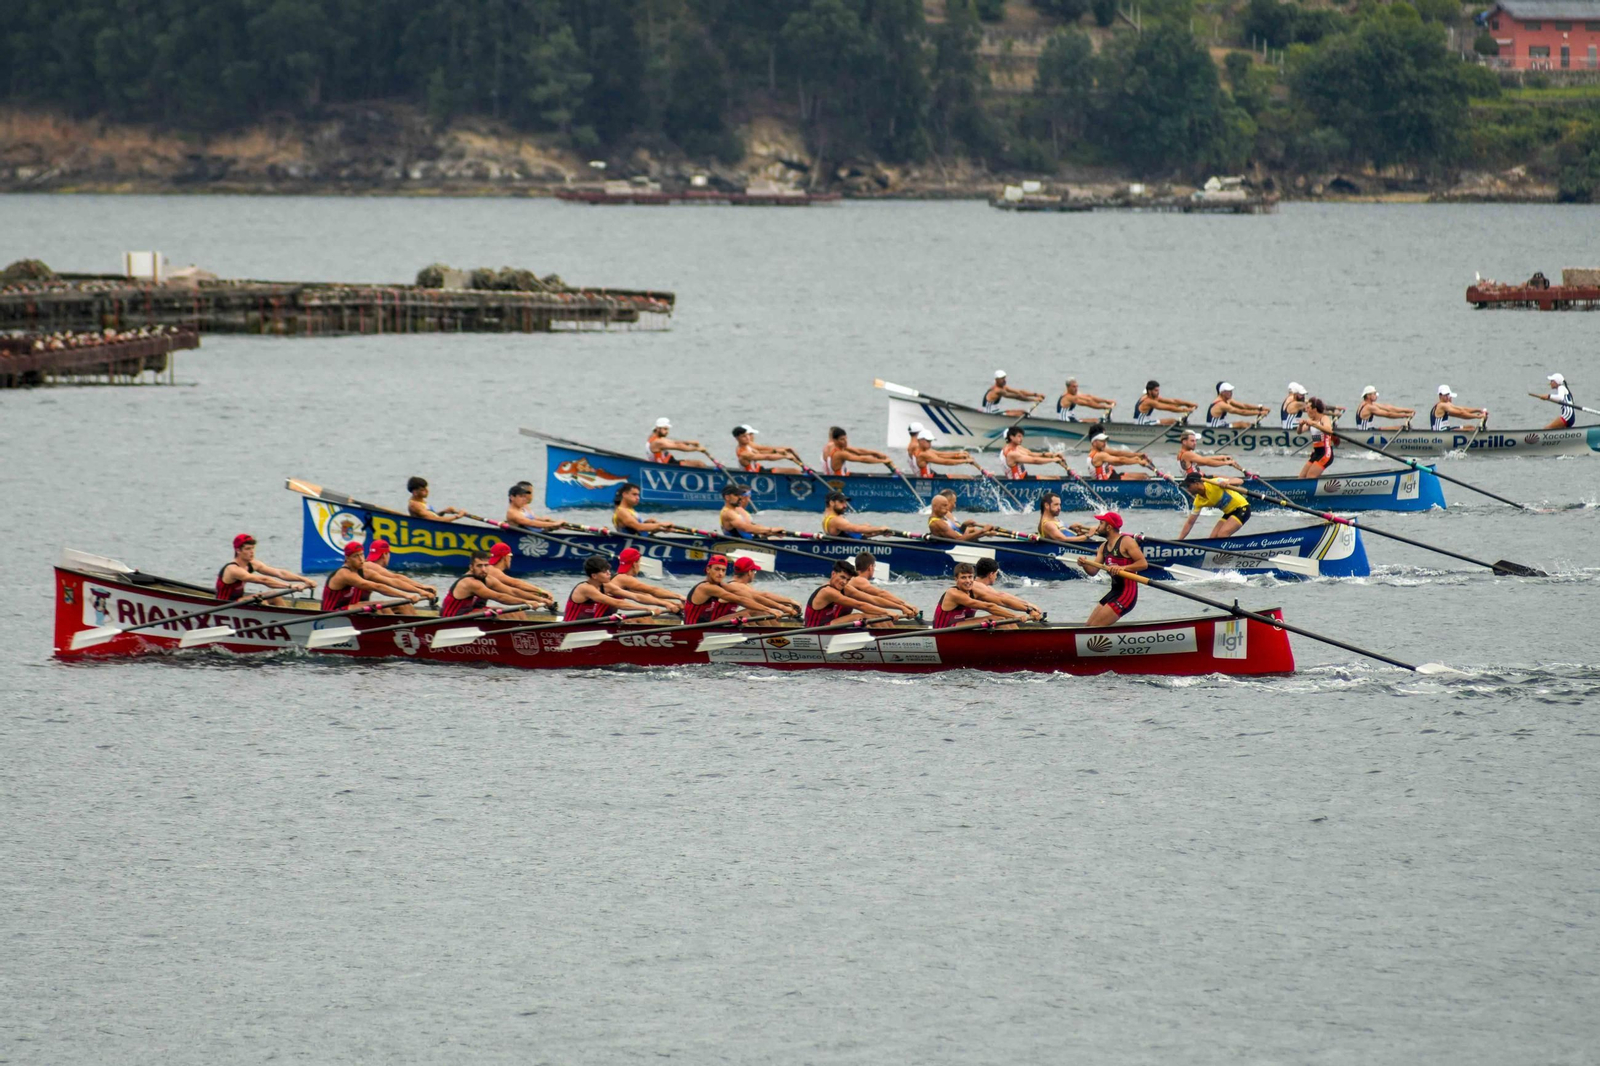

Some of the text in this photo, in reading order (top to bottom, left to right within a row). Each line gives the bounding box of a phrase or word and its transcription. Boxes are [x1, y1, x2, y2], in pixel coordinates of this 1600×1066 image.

[1202, 429, 1309, 450] Salgado
[1453, 435, 1517, 448] Perillo
[1543, 432, 1582, 440] Xacobeo
[1345, 479, 1389, 487] Xacobeo
[372, 516, 503, 551] Rianxo
[823, 545, 892, 556] JJCHICOLINO
[1143, 546, 1205, 557] Rianxo
[117, 599, 291, 641] RIANXEIRA
[1117, 632, 1186, 645] Xacobeo
[448, 645, 499, 655] CORUÑA
[1119, 646, 1151, 655] 2027
